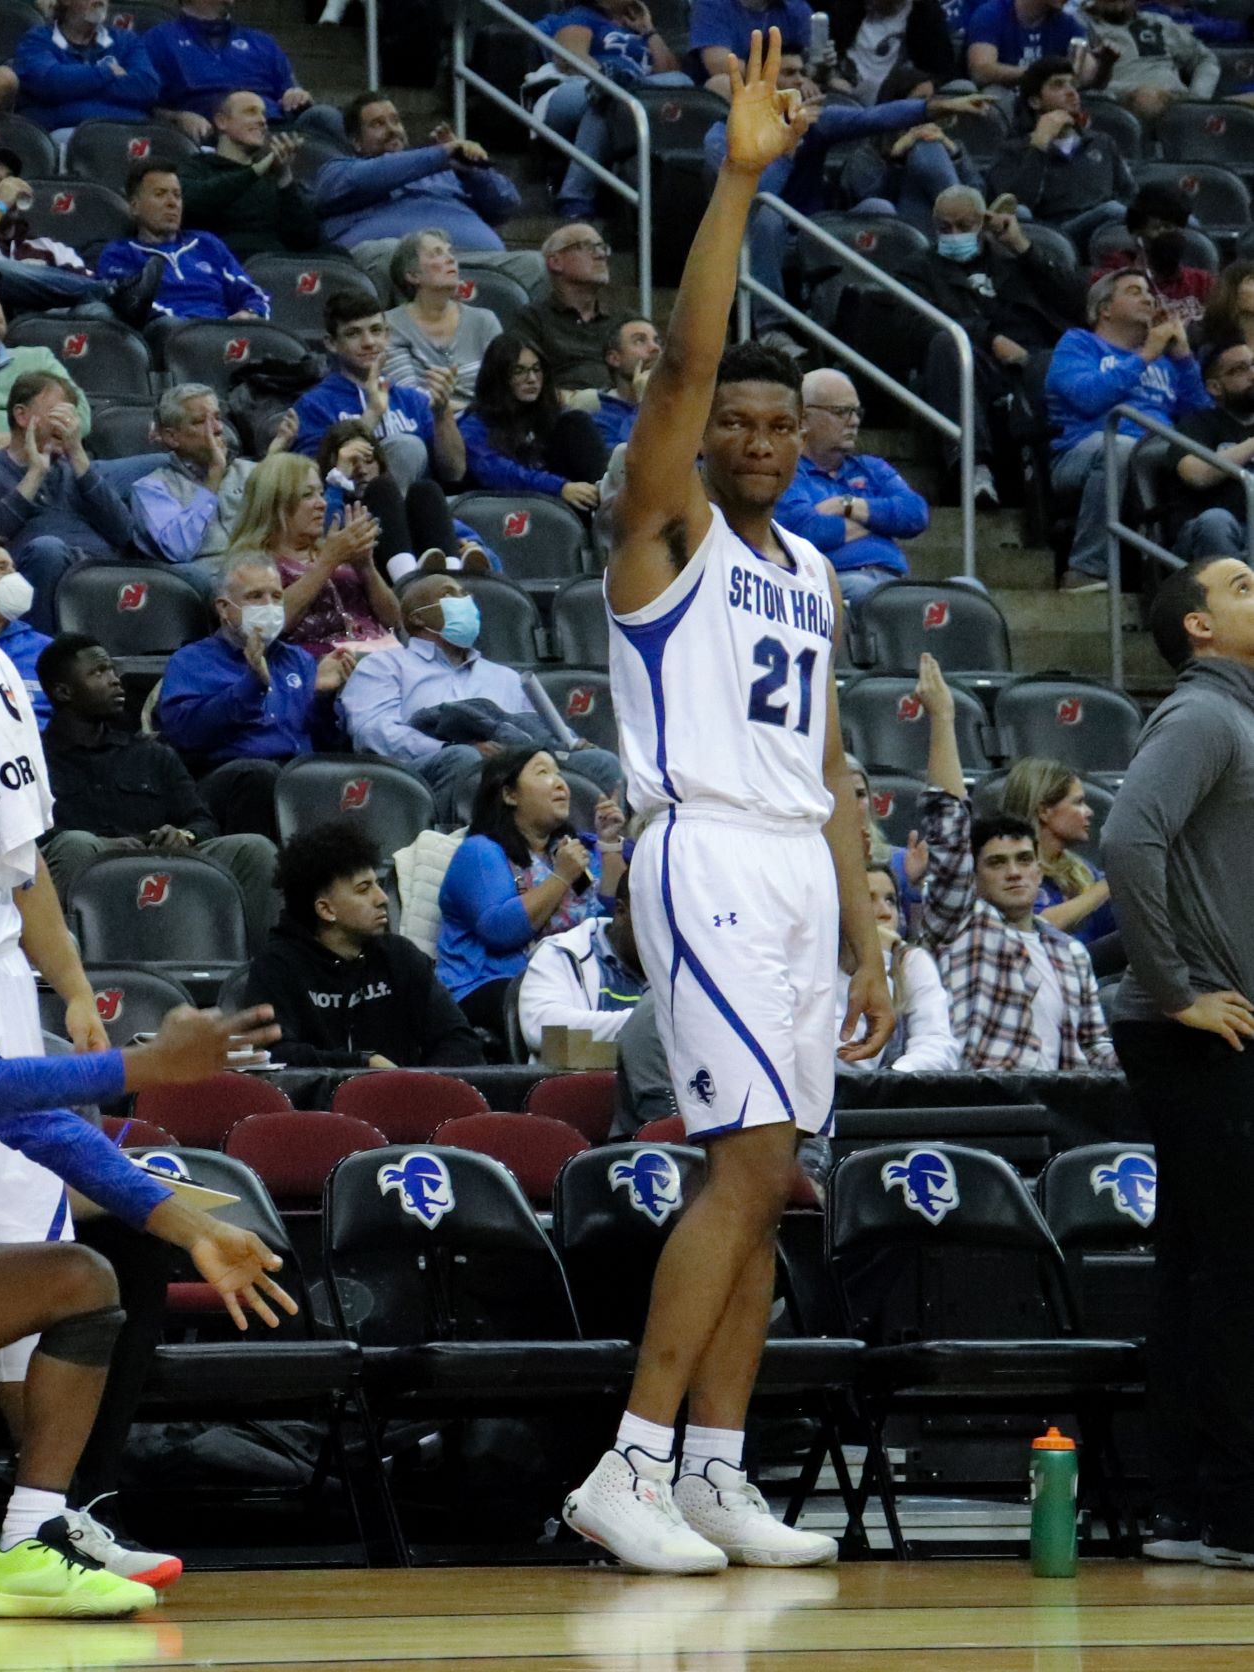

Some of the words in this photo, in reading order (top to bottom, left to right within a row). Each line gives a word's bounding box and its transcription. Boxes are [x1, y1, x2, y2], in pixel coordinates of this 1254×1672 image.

[728, 565, 789, 626] SETON
[790, 589, 834, 643] HALL
[747, 634, 818, 738] 21
[308, 990, 343, 1009] NOT
